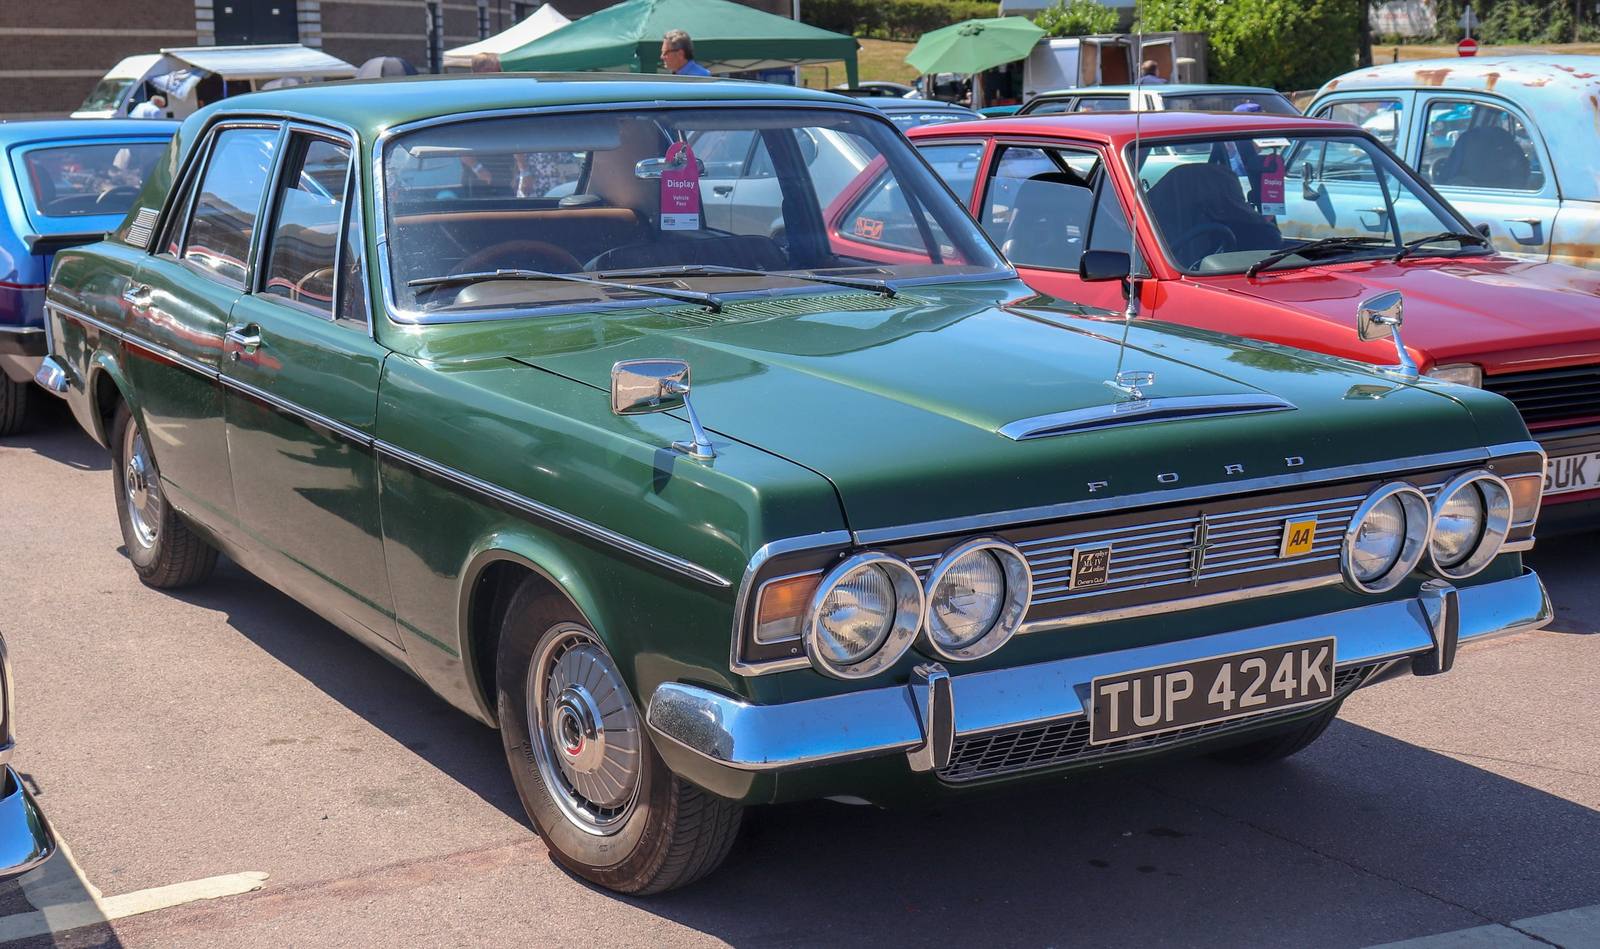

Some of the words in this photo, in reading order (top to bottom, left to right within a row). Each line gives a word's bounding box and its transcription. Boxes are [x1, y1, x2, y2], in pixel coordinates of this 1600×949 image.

[667, 179, 695, 189] Display
[1087, 456, 1304, 492] FORD
[1290, 528, 1310, 547] AA
[1100, 670, 1194, 733] TUP
[1208, 646, 1329, 711] 424K
